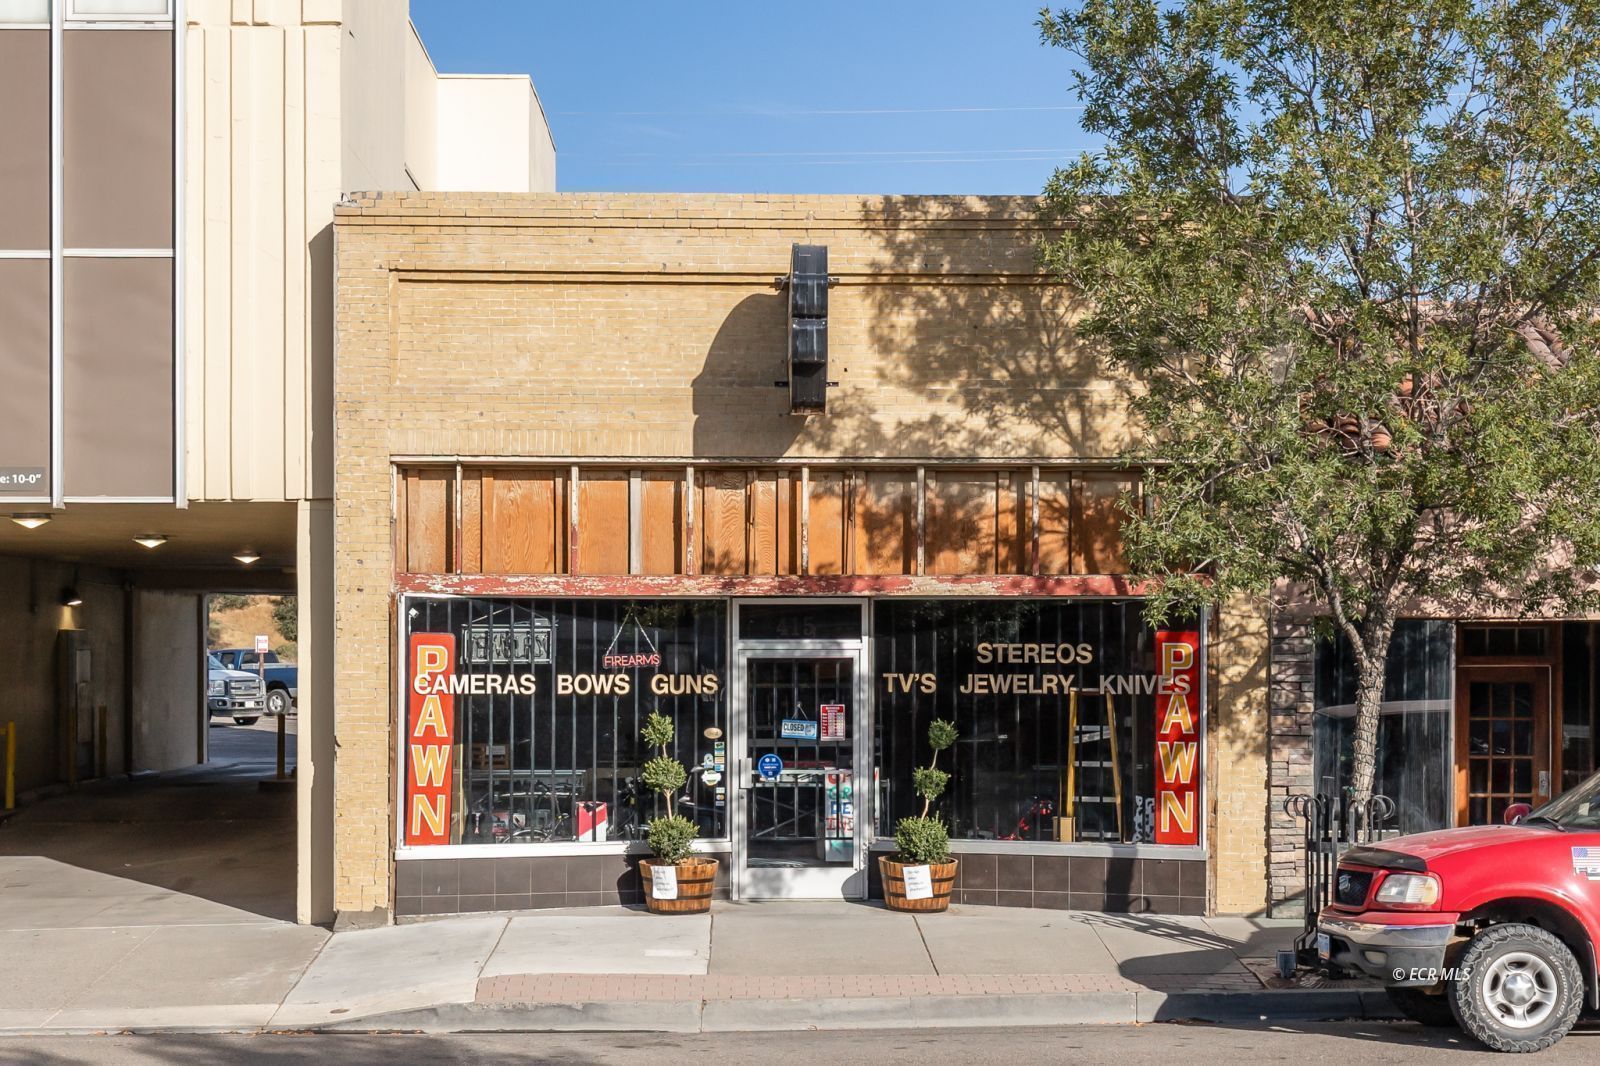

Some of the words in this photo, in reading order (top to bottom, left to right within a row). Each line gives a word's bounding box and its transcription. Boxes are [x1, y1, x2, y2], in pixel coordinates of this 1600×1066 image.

[604, 654, 660, 667] FIREARMS
[977, 643, 1093, 664] STEREOS
[413, 673, 536, 695] CAMERAS
[557, 673, 630, 695] BOWS
[651, 673, 719, 695] GUNS
[883, 673, 937, 694] TV'S
[960, 674, 1075, 695] JEWELRY
[1099, 674, 1191, 696] KNIVES
[784, 723, 804, 732] CLOSED
[1158, 642, 1197, 833] PAWN
[411, 645, 451, 836] PAWN
